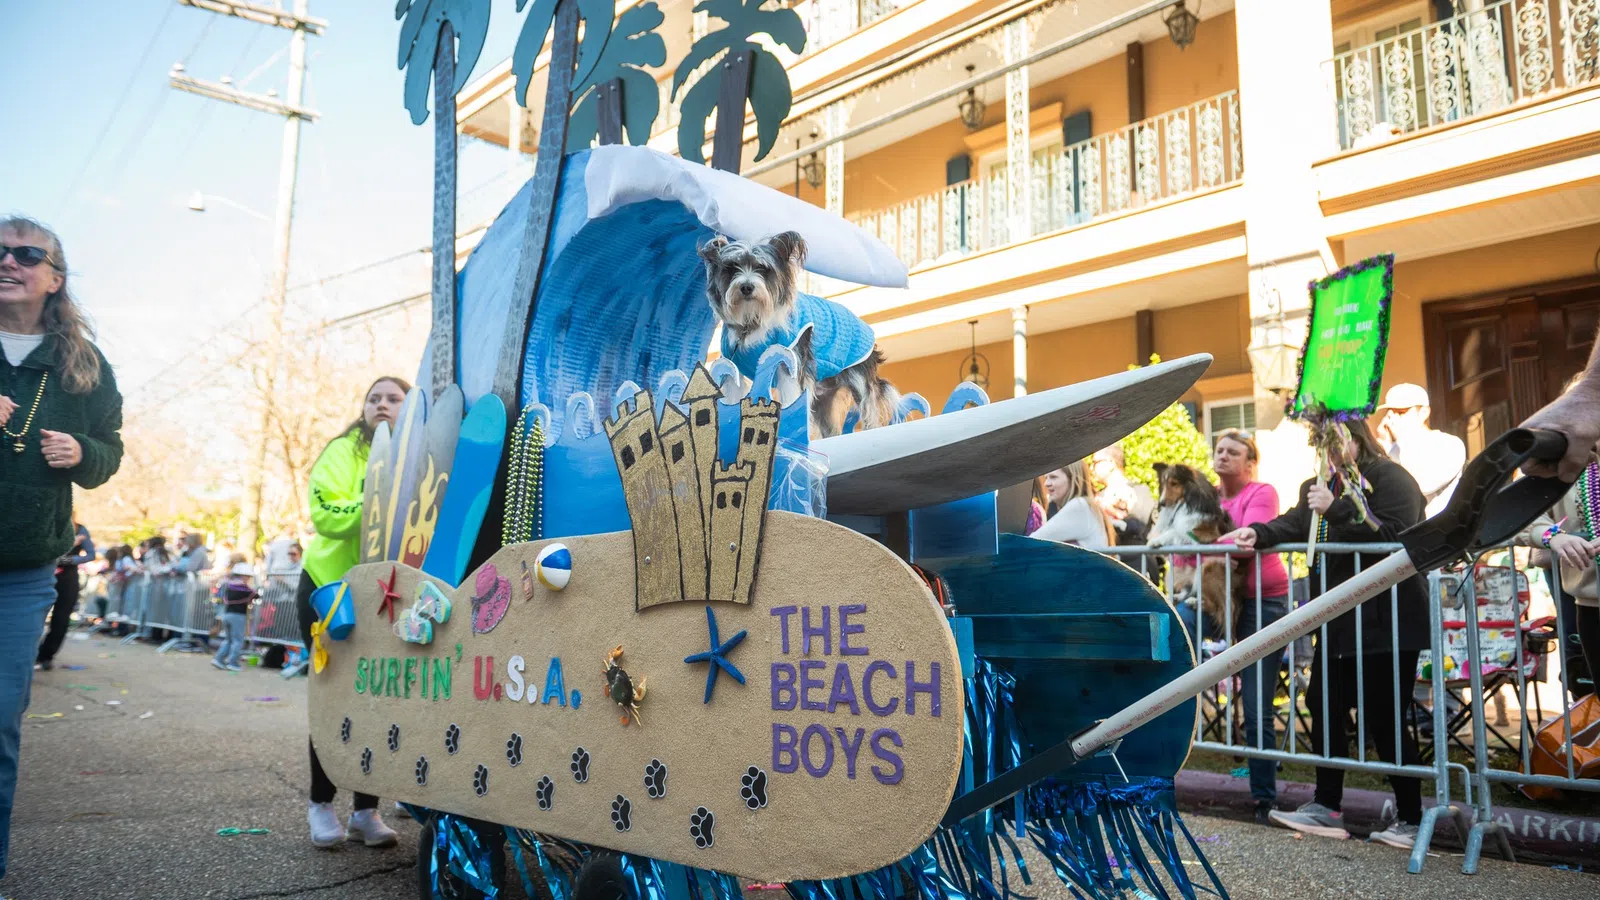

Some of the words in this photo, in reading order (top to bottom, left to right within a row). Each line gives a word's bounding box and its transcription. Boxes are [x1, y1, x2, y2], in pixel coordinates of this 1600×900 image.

[367, 460, 384, 558] TAZ
[770, 604, 869, 656] THE
[354, 643, 463, 701] SURFIN'
[473, 655, 582, 710] U.S.A.
[771, 660, 941, 717] BEACH
[772, 723, 904, 785] BOYS
